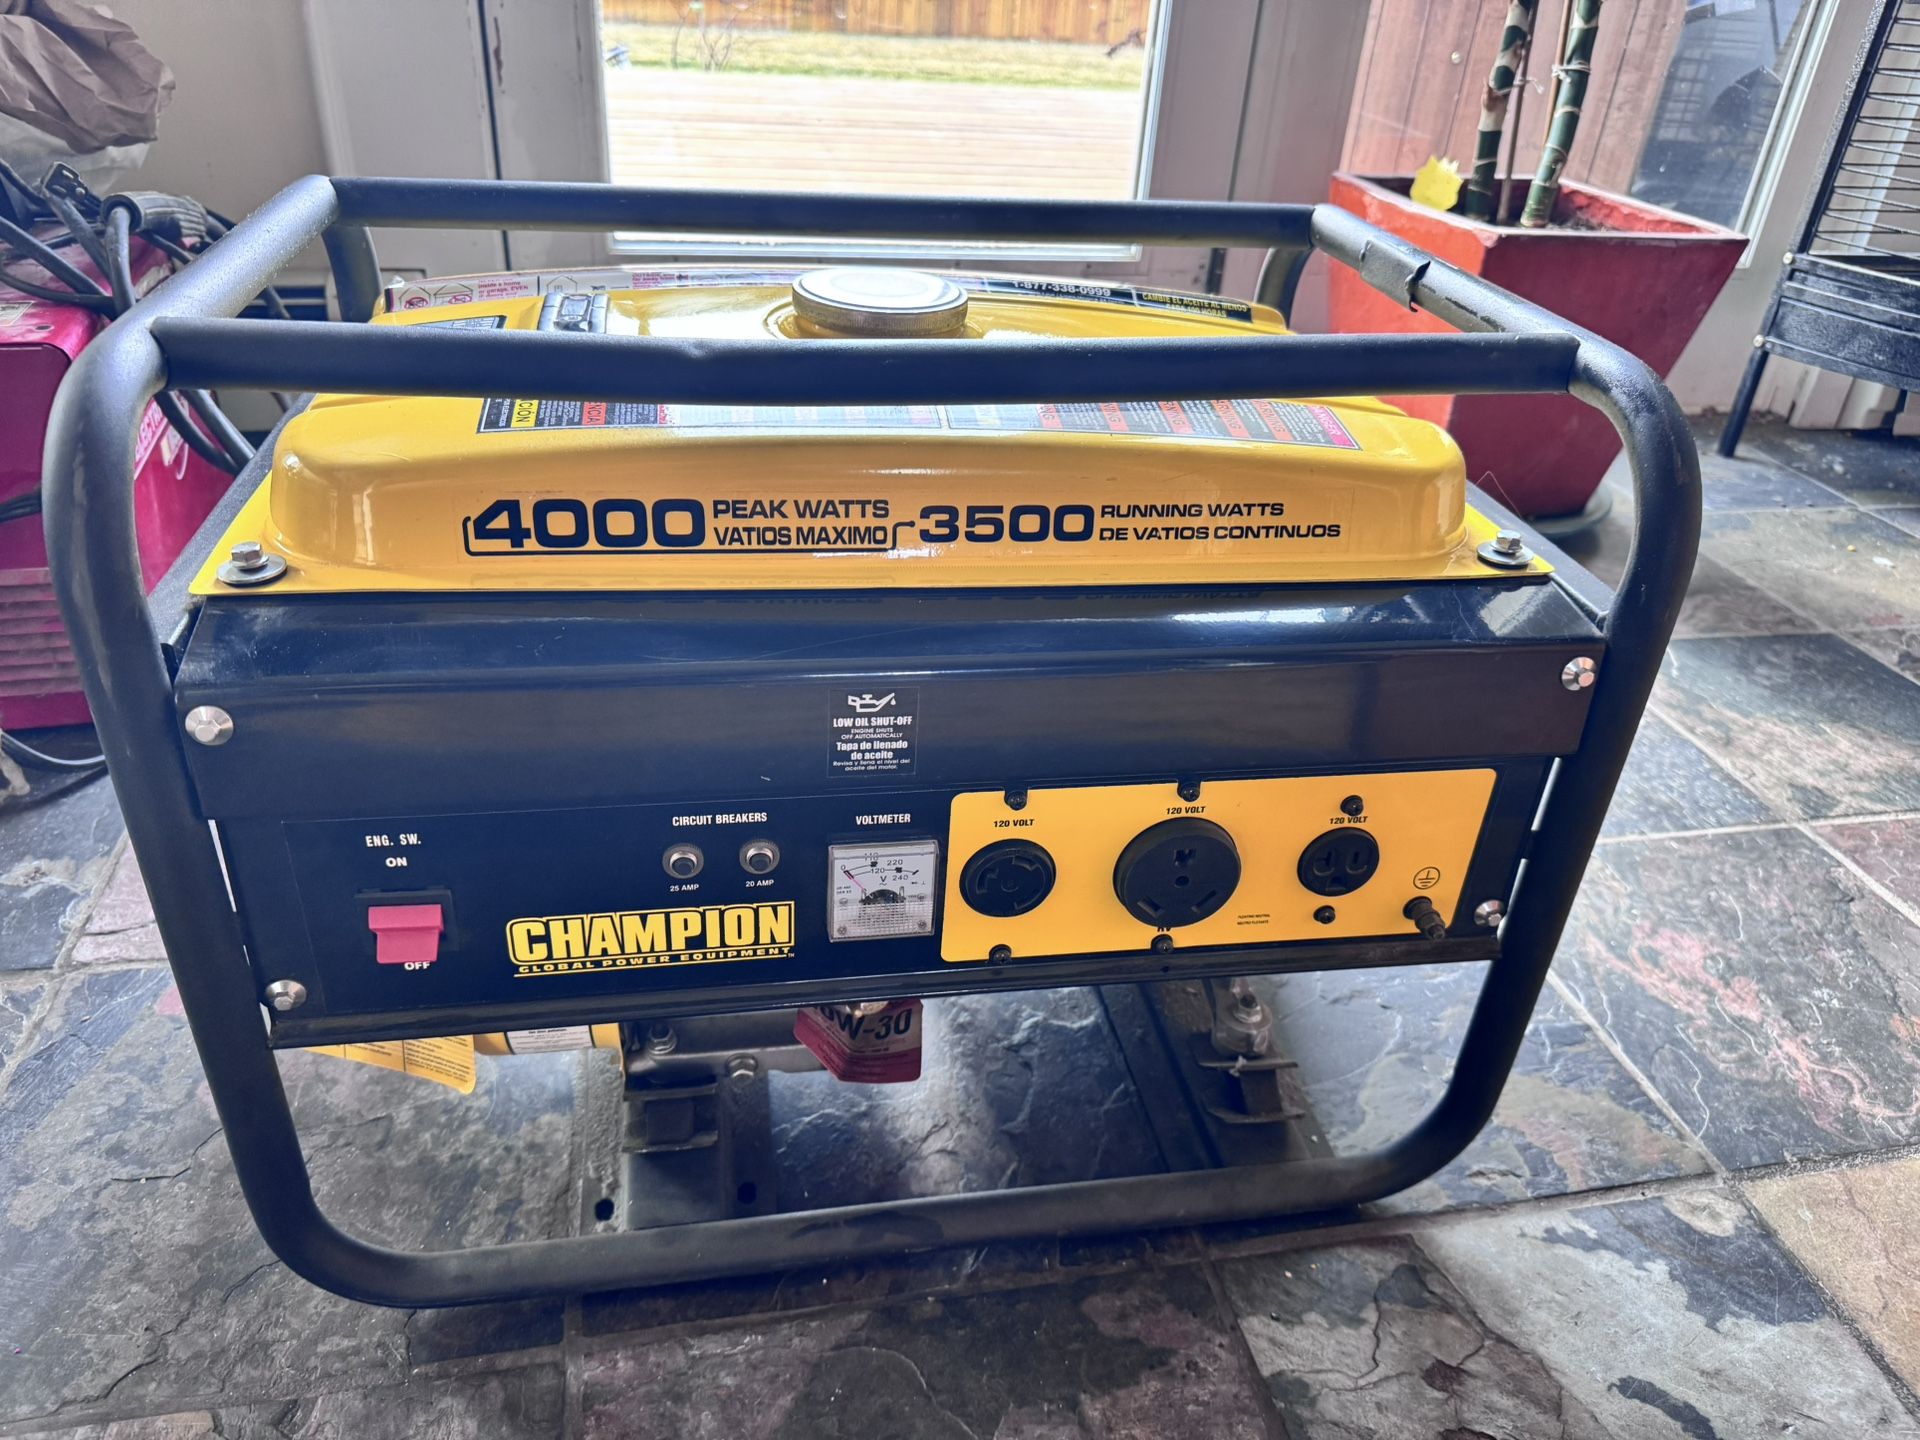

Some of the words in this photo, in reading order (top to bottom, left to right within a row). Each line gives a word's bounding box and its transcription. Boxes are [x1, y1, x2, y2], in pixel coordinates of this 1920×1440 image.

[713, 499, 788, 519] PEAK
[793, 498, 890, 519] WATTS
[1100, 502, 1204, 519] RUNNING
[1207, 502, 1285, 518] WATTS
[473, 498, 706, 549] 4000
[919, 504, 1096, 543] 3500
[713, 526, 792, 547] VATIOS
[795, 524, 889, 546] MAXIMO
[1099, 526, 1129, 542] DE
[1132, 525, 1210, 541] VATIOS
[1213, 523, 1341, 540] CONTINUOS
[833, 718, 853, 728] LOW
[854, 717, 869, 727] OIL
[870, 716, 913, 727] SHUT-OFF
[854, 732, 903, 740] AUTOMATICALLY
[836, 742, 858, 752] Tapa
[860, 741, 872, 750] de
[873, 739, 908, 750] llenado
[851, 751, 863, 760] de
[864, 750, 893, 760] aceite
[1166, 807, 1182, 815] 120
[1184, 805, 1206, 814] VOLT
[672, 814, 713, 827] CIRCUIT
[715, 812, 768, 825] BREAKERS
[856, 813, 912, 825] VOLTMETER
[994, 820, 1010, 828] 120
[1012, 818, 1035, 827] VOLT
[1329, 817, 1345, 825] 120
[1347, 815, 1369, 824] VOLT
[365, 834, 395, 848] ENG.
[399, 833, 422, 846] SW.
[385, 857, 408, 868] ON
[681, 883, 700, 891] AMP
[745, 880, 755, 888] 20
[756, 879, 775, 887] AMP
[508, 903, 793, 964] CHAMPION
[404, 961, 431, 971] OFF
[518, 959, 595, 974] GLOBAL
[602, 954, 670, 967] POWER
[680, 946, 791, 962] EQUIPMENT
